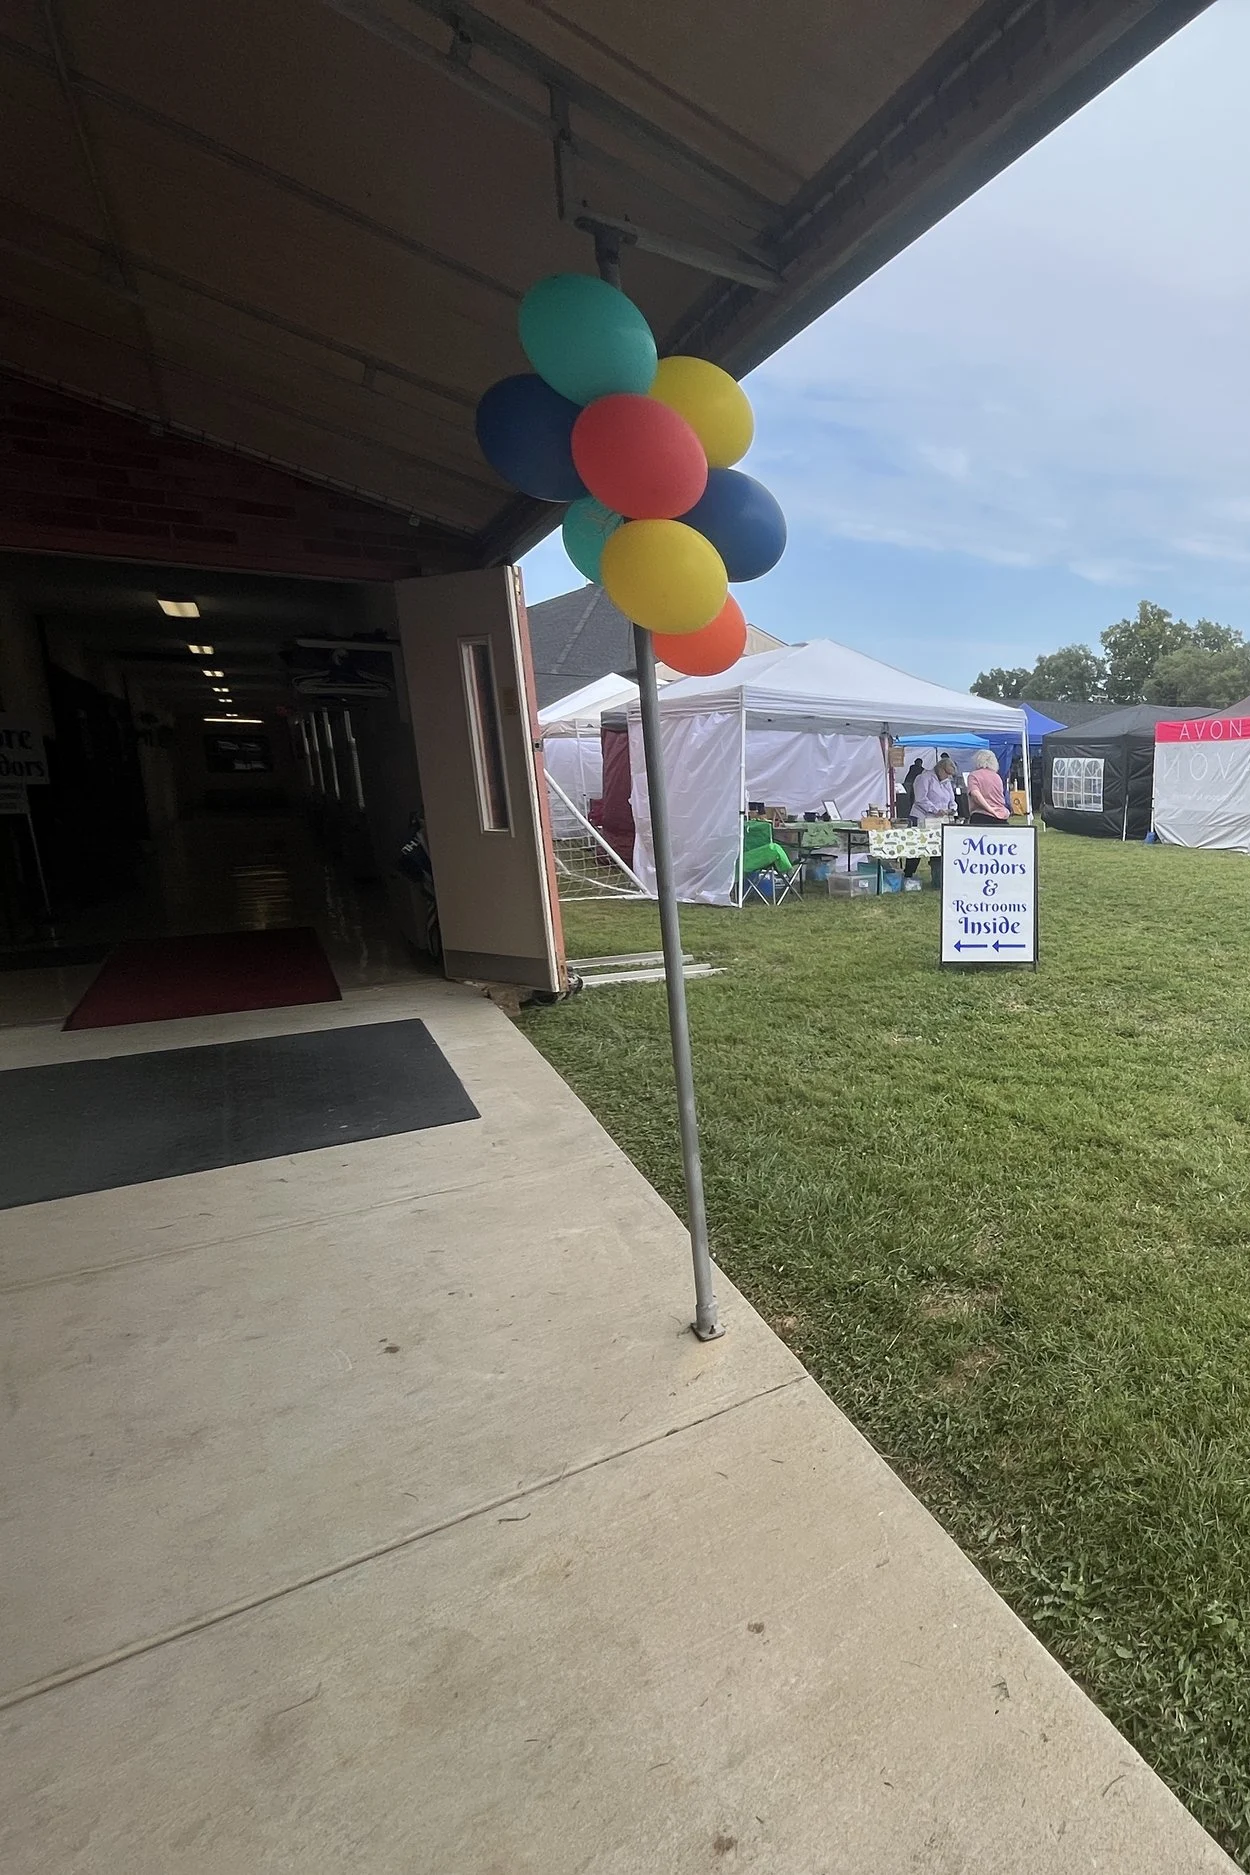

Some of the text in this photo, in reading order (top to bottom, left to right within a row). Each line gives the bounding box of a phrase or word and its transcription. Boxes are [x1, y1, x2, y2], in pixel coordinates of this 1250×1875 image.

[0, 729, 33, 750] ore
[1179, 719, 1242, 741] AVON
[0, 754, 44, 777] dors
[961, 834, 1018, 856] More
[953, 858, 1026, 876] Vendors
[982, 879, 999, 897] &
[952, 899, 1027, 915] Restrooms
[958, 916, 1021, 936] Inside
